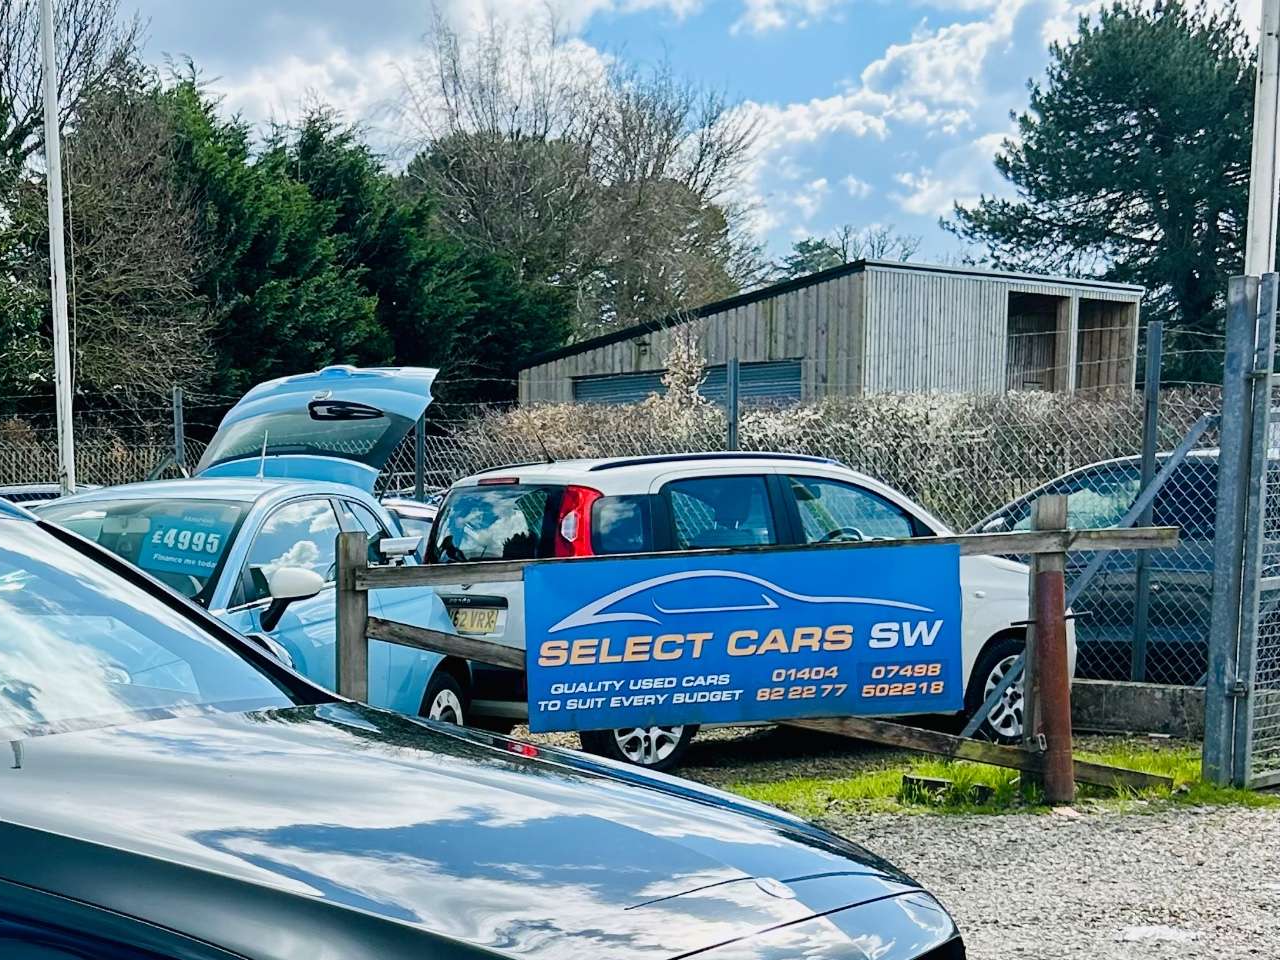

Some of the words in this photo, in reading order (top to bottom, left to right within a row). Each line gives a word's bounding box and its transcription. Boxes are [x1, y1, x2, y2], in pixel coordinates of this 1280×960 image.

[152, 528, 221, 554] £4995
[470, 610, 495, 628] VRX
[538, 632, 714, 667] SELECT
[727, 624, 854, 656] CARS
[868, 620, 944, 648] SW
[771, 665, 839, 682] 01404
[871, 663, 942, 679] 07498
[550, 679, 625, 695] QUALITY
[629, 676, 677, 690] USED
[682, 674, 731, 687] CARS
[861, 681, 944, 698] 502218
[538, 700, 562, 711] TO
[565, 697, 606, 710] SUIT
[609, 693, 669, 708] EVERY
[672, 689, 745, 704] BUDGET
